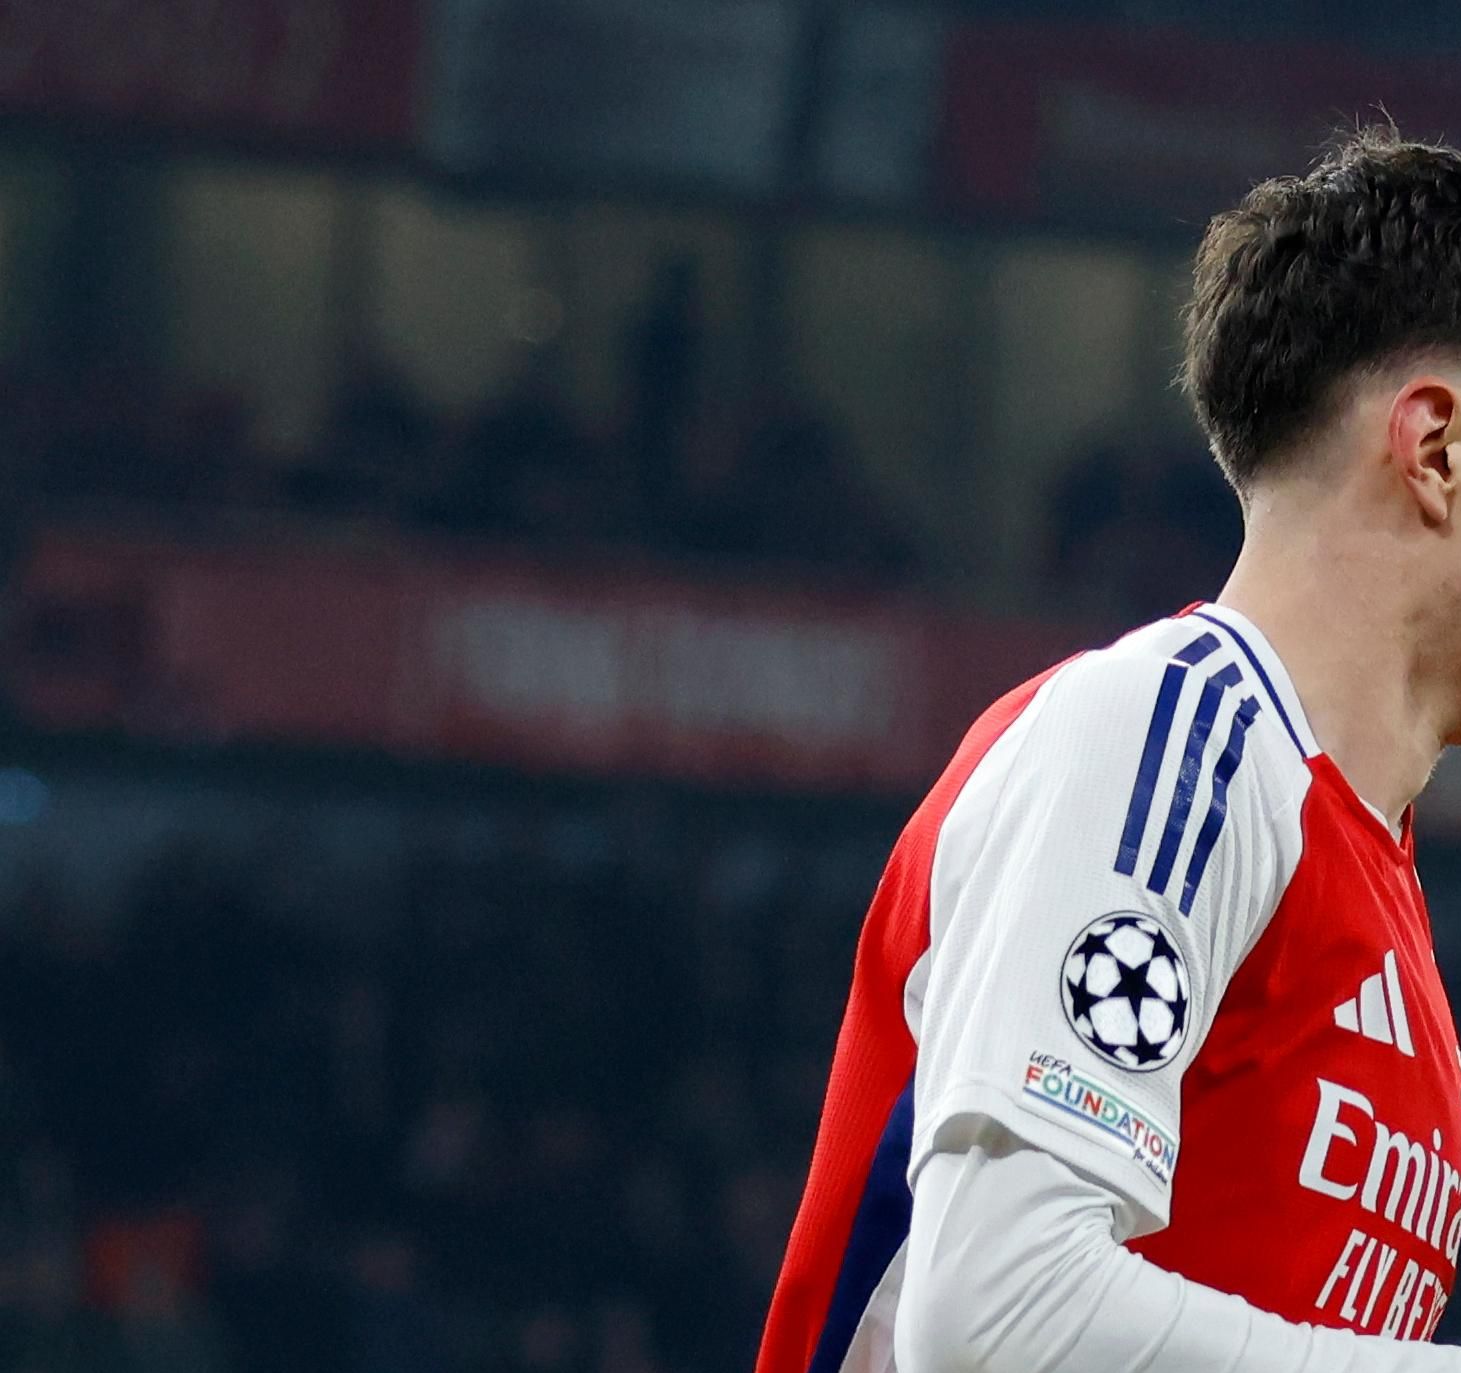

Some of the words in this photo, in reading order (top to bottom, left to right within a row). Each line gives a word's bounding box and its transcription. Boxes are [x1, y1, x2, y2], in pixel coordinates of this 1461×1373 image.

[1029, 1050, 1072, 1077] UEFA
[1025, 1064, 1175, 1171] FOUNDATION
[1314, 1228, 1398, 1329] FLY
